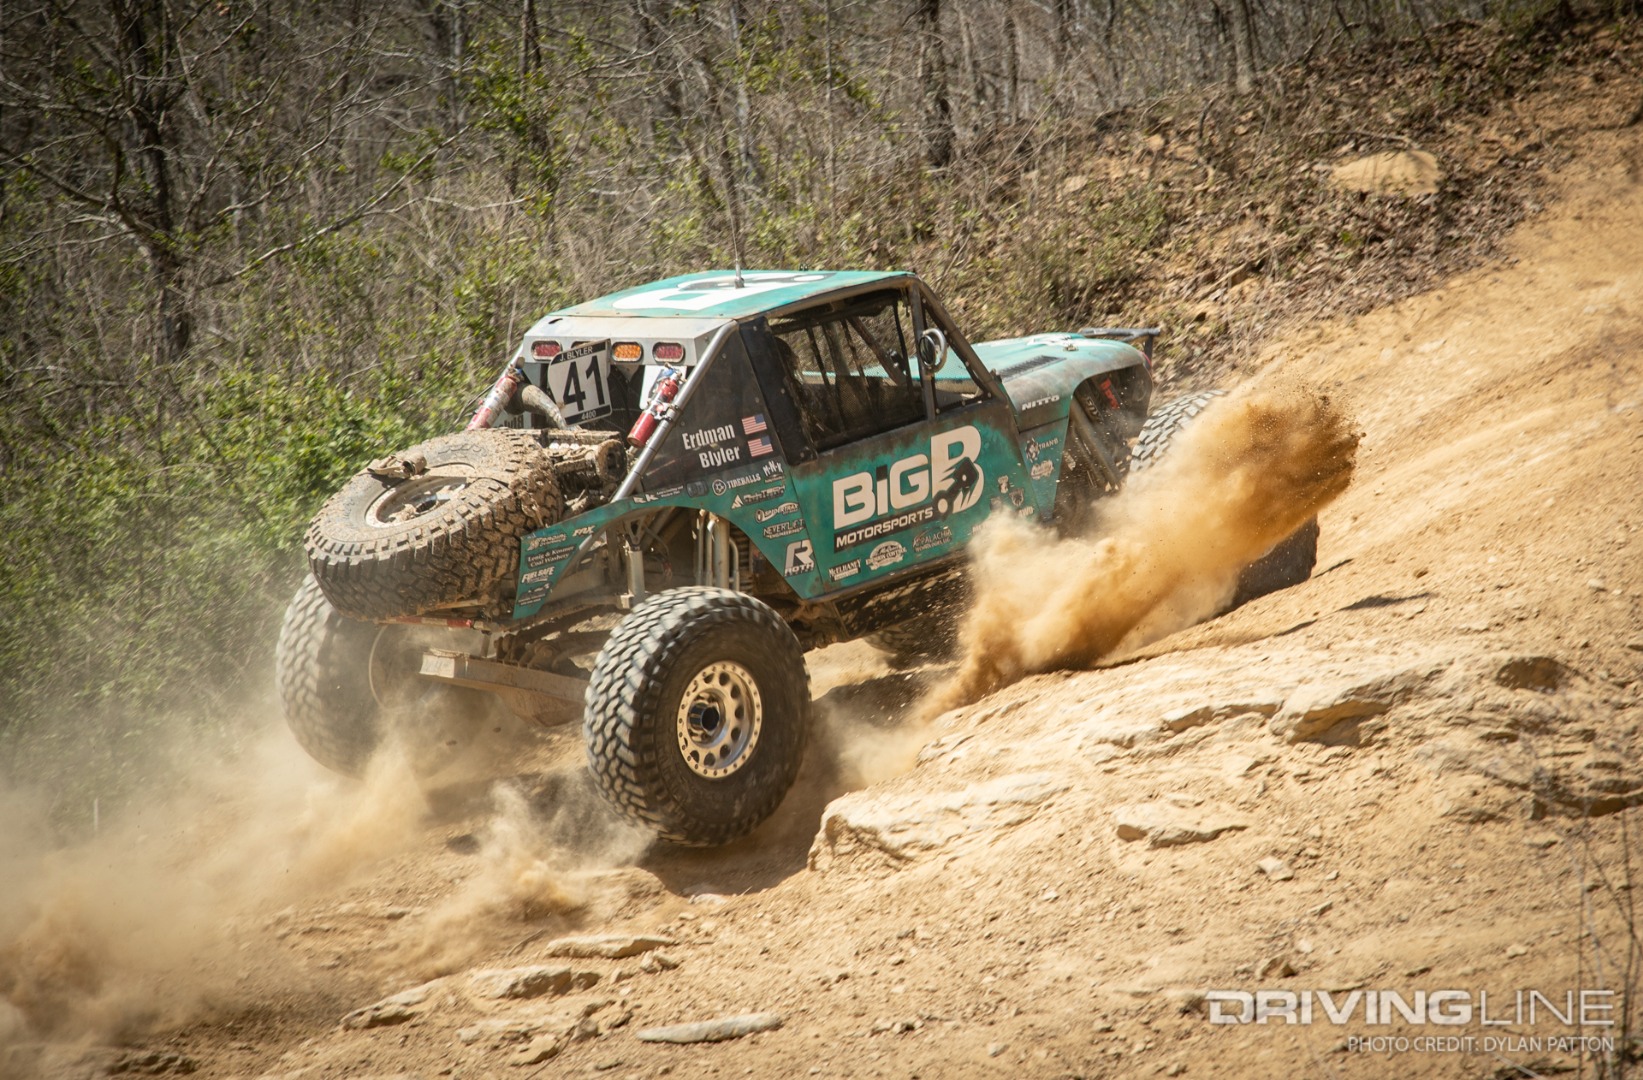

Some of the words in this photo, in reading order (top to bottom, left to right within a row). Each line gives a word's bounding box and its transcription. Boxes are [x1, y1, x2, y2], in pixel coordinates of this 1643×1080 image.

[559, 353, 567, 363] J.
[566, 346, 594, 360] BLYLER
[563, 355, 605, 412] 41
[1021, 394, 1060, 411] NITTO
[581, 410, 597, 421] 4400
[682, 424, 736, 451] Erdman
[699, 446, 741, 469] Blyler
[727, 473, 761, 489] TIREBALLS
[836, 506, 934, 549] MOTORSPORTS
[785, 562, 814, 577] ROTH
